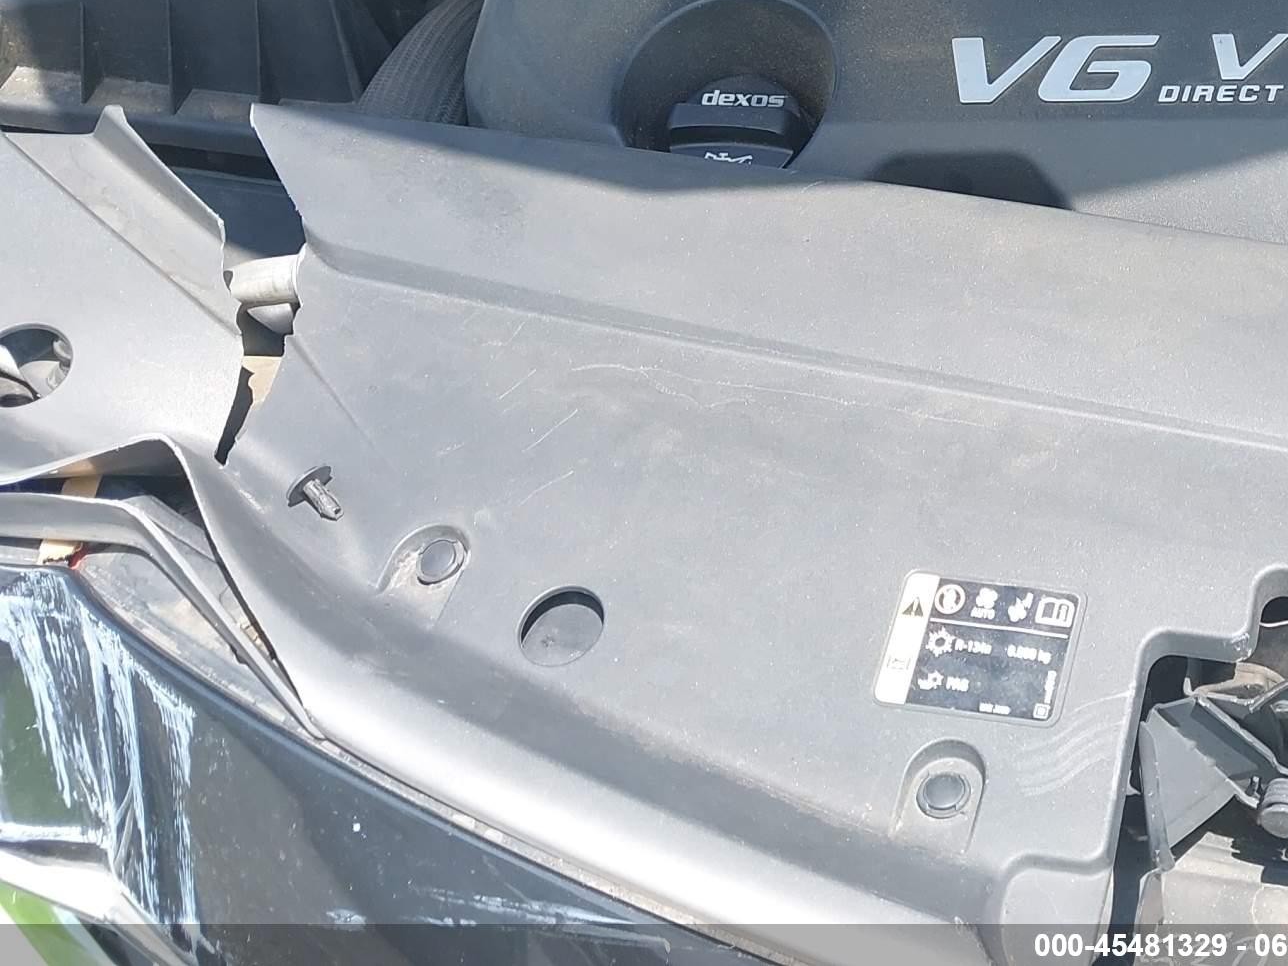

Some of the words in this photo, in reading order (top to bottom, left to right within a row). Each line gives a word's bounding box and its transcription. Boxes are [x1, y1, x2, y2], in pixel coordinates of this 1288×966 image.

[951, 33, 1160, 104] V6
[701, 89, 788, 108] dexos
[1158, 84, 1285, 103] DIRECT
